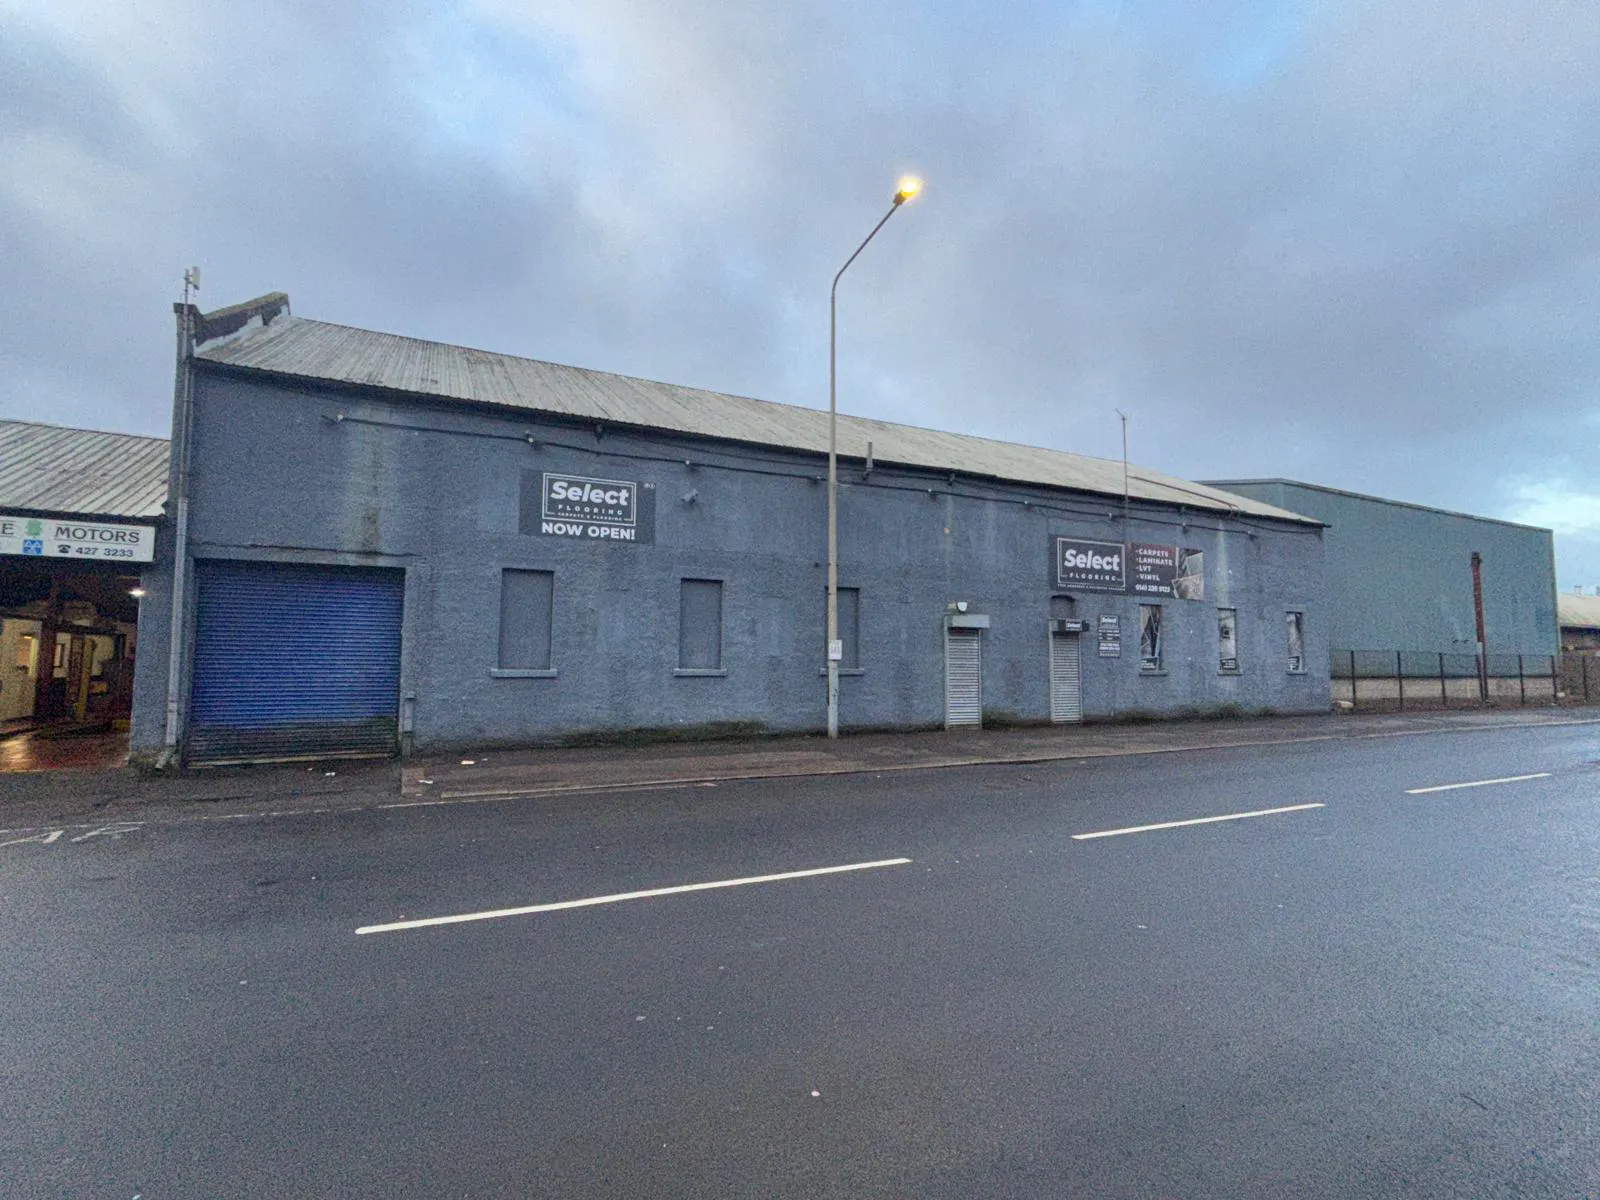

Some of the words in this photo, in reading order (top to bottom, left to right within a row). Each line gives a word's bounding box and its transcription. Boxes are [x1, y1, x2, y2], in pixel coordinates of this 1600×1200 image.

[550, 481, 630, 506] Select
[558, 504, 623, 516] FLOORING
[55, 526, 140, 543] MOTORS
[542, 522, 583, 536] NOW
[587, 526, 636, 540] OPEN!
[75, 547, 98, 556] 427
[103, 548, 134, 558] 3233
[1064, 549, 1120, 571] Select
